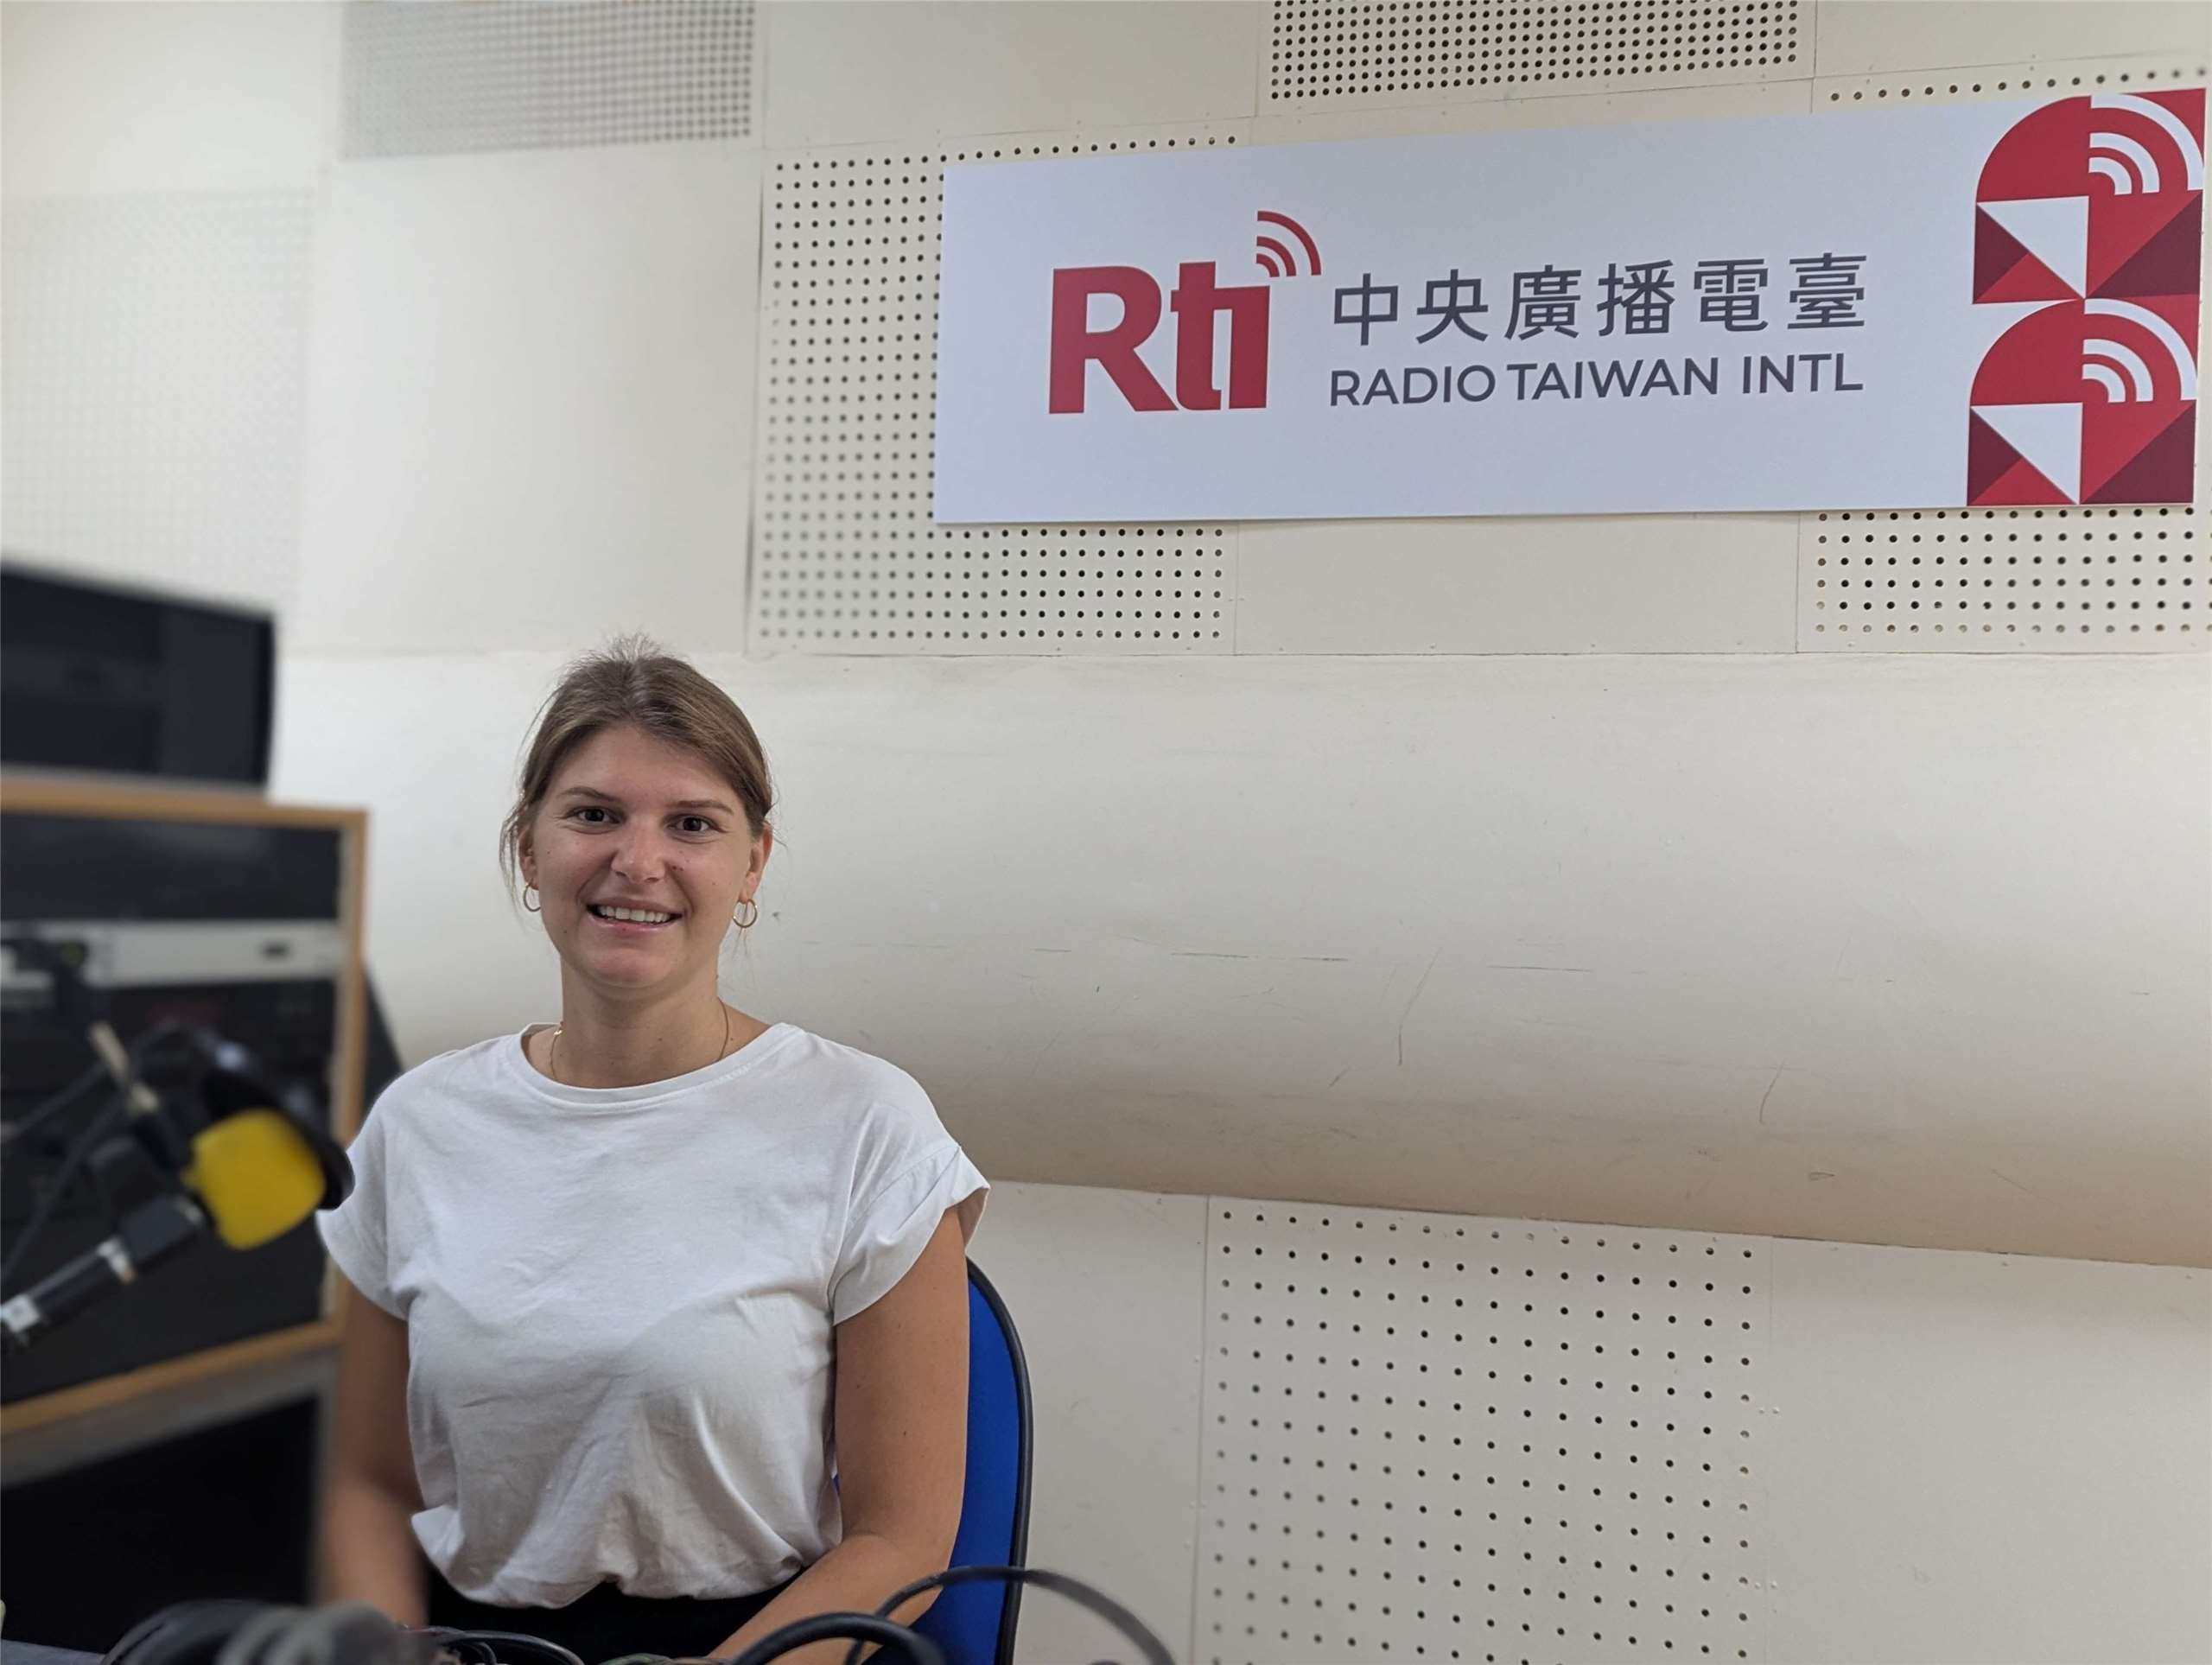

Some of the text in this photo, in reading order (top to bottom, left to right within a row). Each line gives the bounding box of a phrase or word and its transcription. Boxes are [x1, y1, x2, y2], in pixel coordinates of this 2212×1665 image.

[1048, 260, 1271, 415] Rti
[1332, 252, 1867, 346] 中央廣播電臺
[1330, 353, 1864, 407] RADIO TAIWAN INTL
